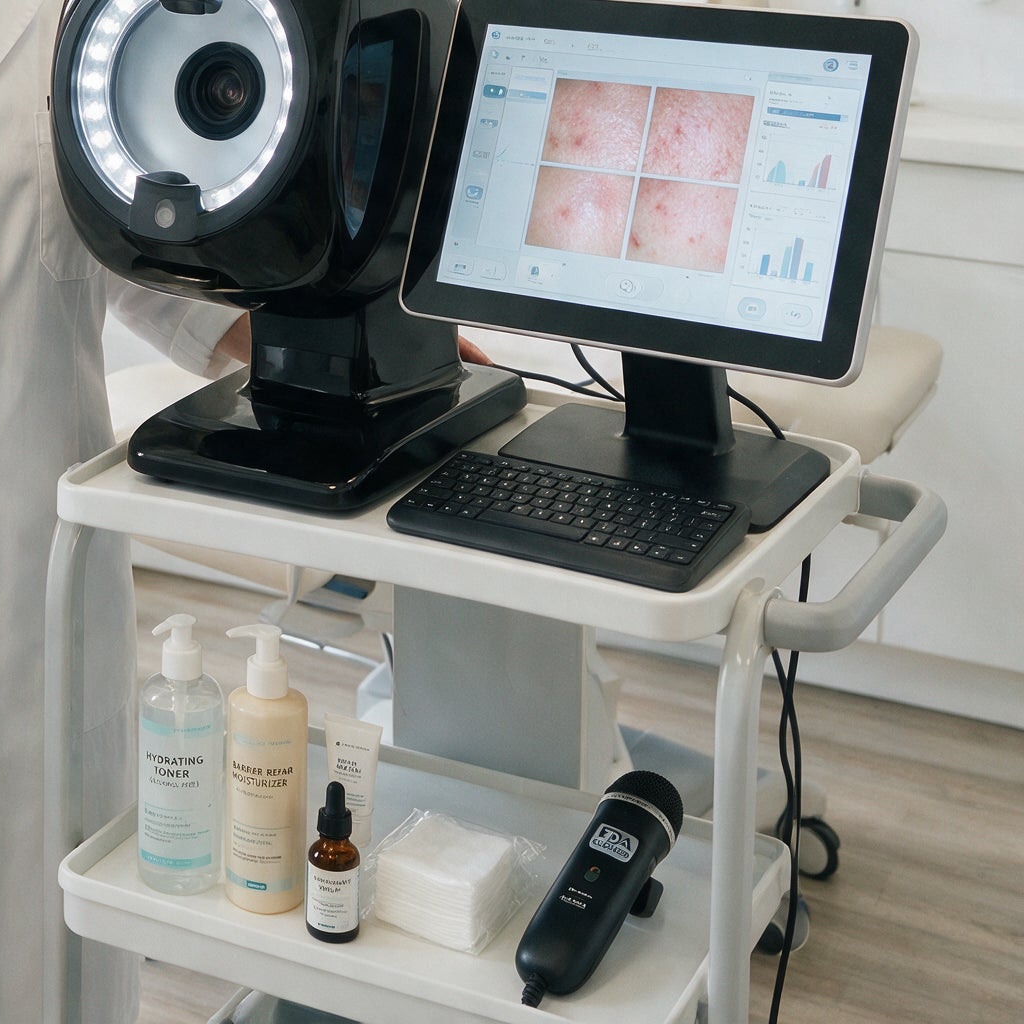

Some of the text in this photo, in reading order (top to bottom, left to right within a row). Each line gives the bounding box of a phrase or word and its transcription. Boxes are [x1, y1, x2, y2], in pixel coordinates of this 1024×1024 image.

[146, 750, 205, 767] HYDRATING
[154, 765, 190, 779] TONER
[232, 771, 289, 789] MOISTURIZER
